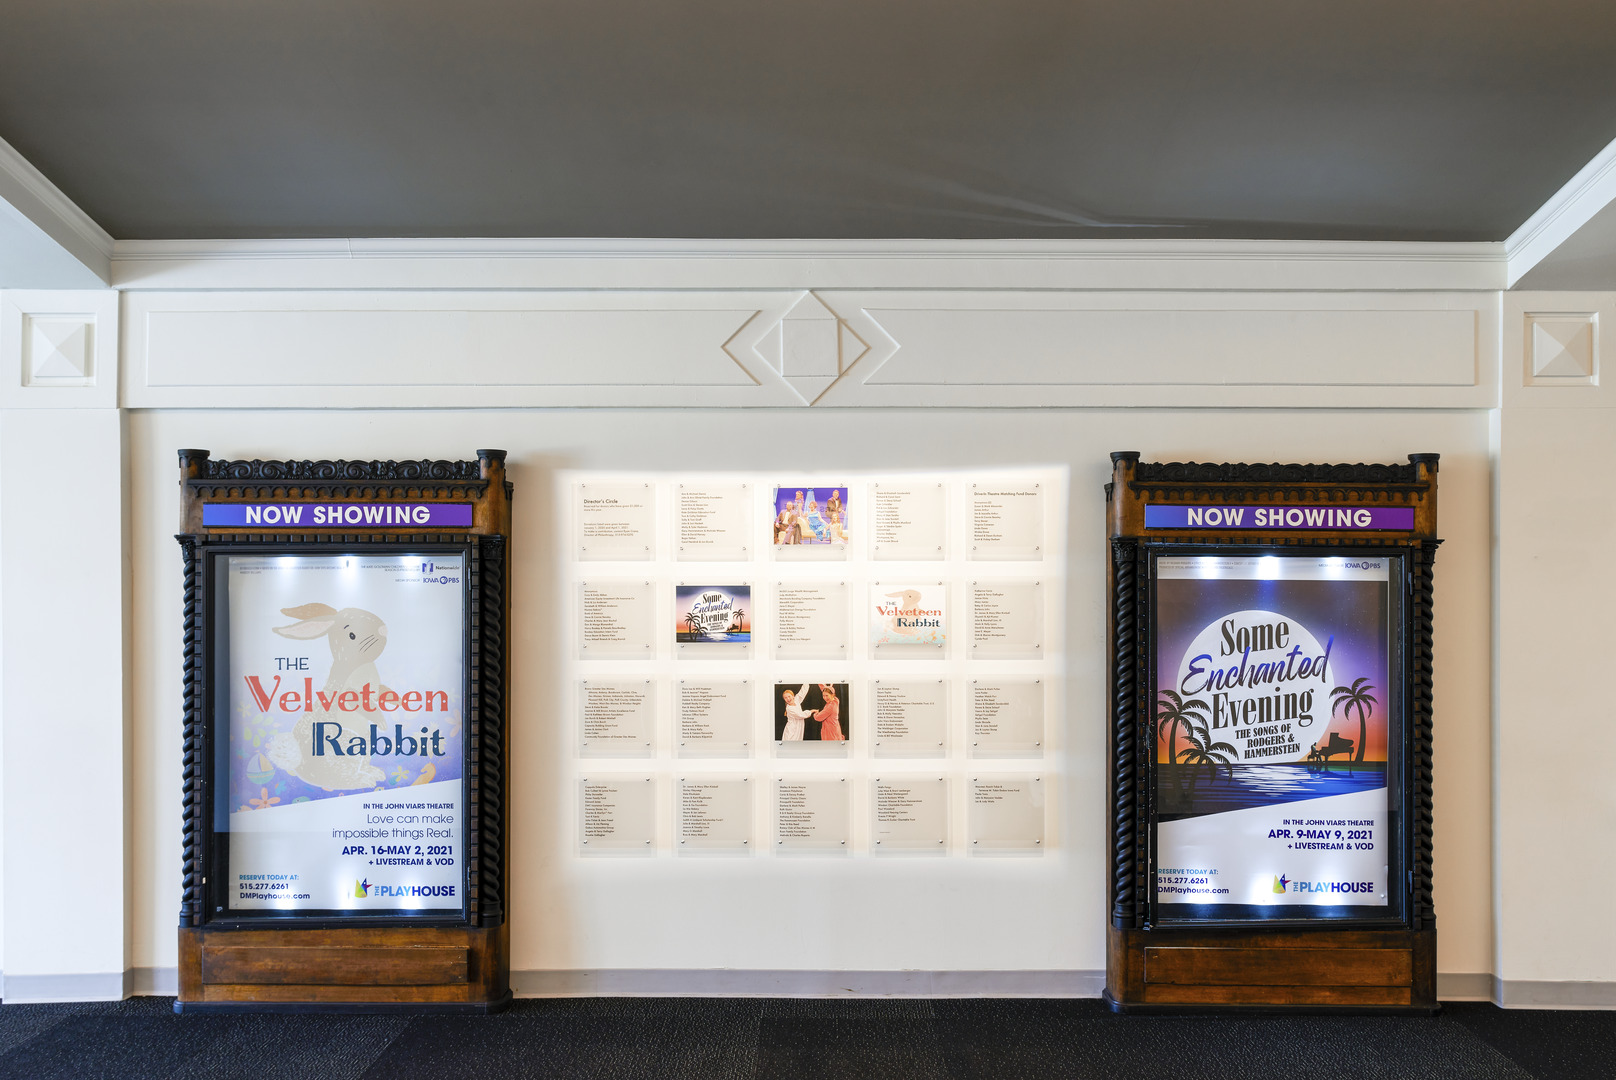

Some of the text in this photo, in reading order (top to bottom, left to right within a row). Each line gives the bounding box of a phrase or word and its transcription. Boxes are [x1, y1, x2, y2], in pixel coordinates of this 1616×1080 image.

[246, 506, 430, 523] NOW SHOWING
[1188, 508, 1372, 527] NOW SHOWING
[692, 597, 734, 614] Enchanted
[703, 594, 722, 604] Some
[701, 612, 728, 623] Evening
[876, 606, 941, 616] Velveteen
[897, 618, 941, 627] Rabbit
[1221, 619, 1289, 656] Some
[275, 658, 309, 670] THE
[1181, 634, 1334, 696] Enchanted
[244, 675, 448, 712] Velveteen
[1212, 687, 1314, 729] Evening
[1235, 723, 1291, 739] THE SONGS OF
[312, 722, 446, 756] Rabbit
[1247, 733, 1294, 748] RODGERS &
[1244, 743, 1300, 759] HAMMERSTEIN
[367, 814, 454, 824] Love can make
[332, 828, 453, 840] impossible things Real.
[1268, 830, 1373, 841] APR. 9-MAY 9, 2021
[342, 846, 453, 857] APR. 16-MAY 2, 2021
[381, 885, 455, 897] PLAYHOUSE
[1300, 882, 1373, 893] PLAYHOUSE
